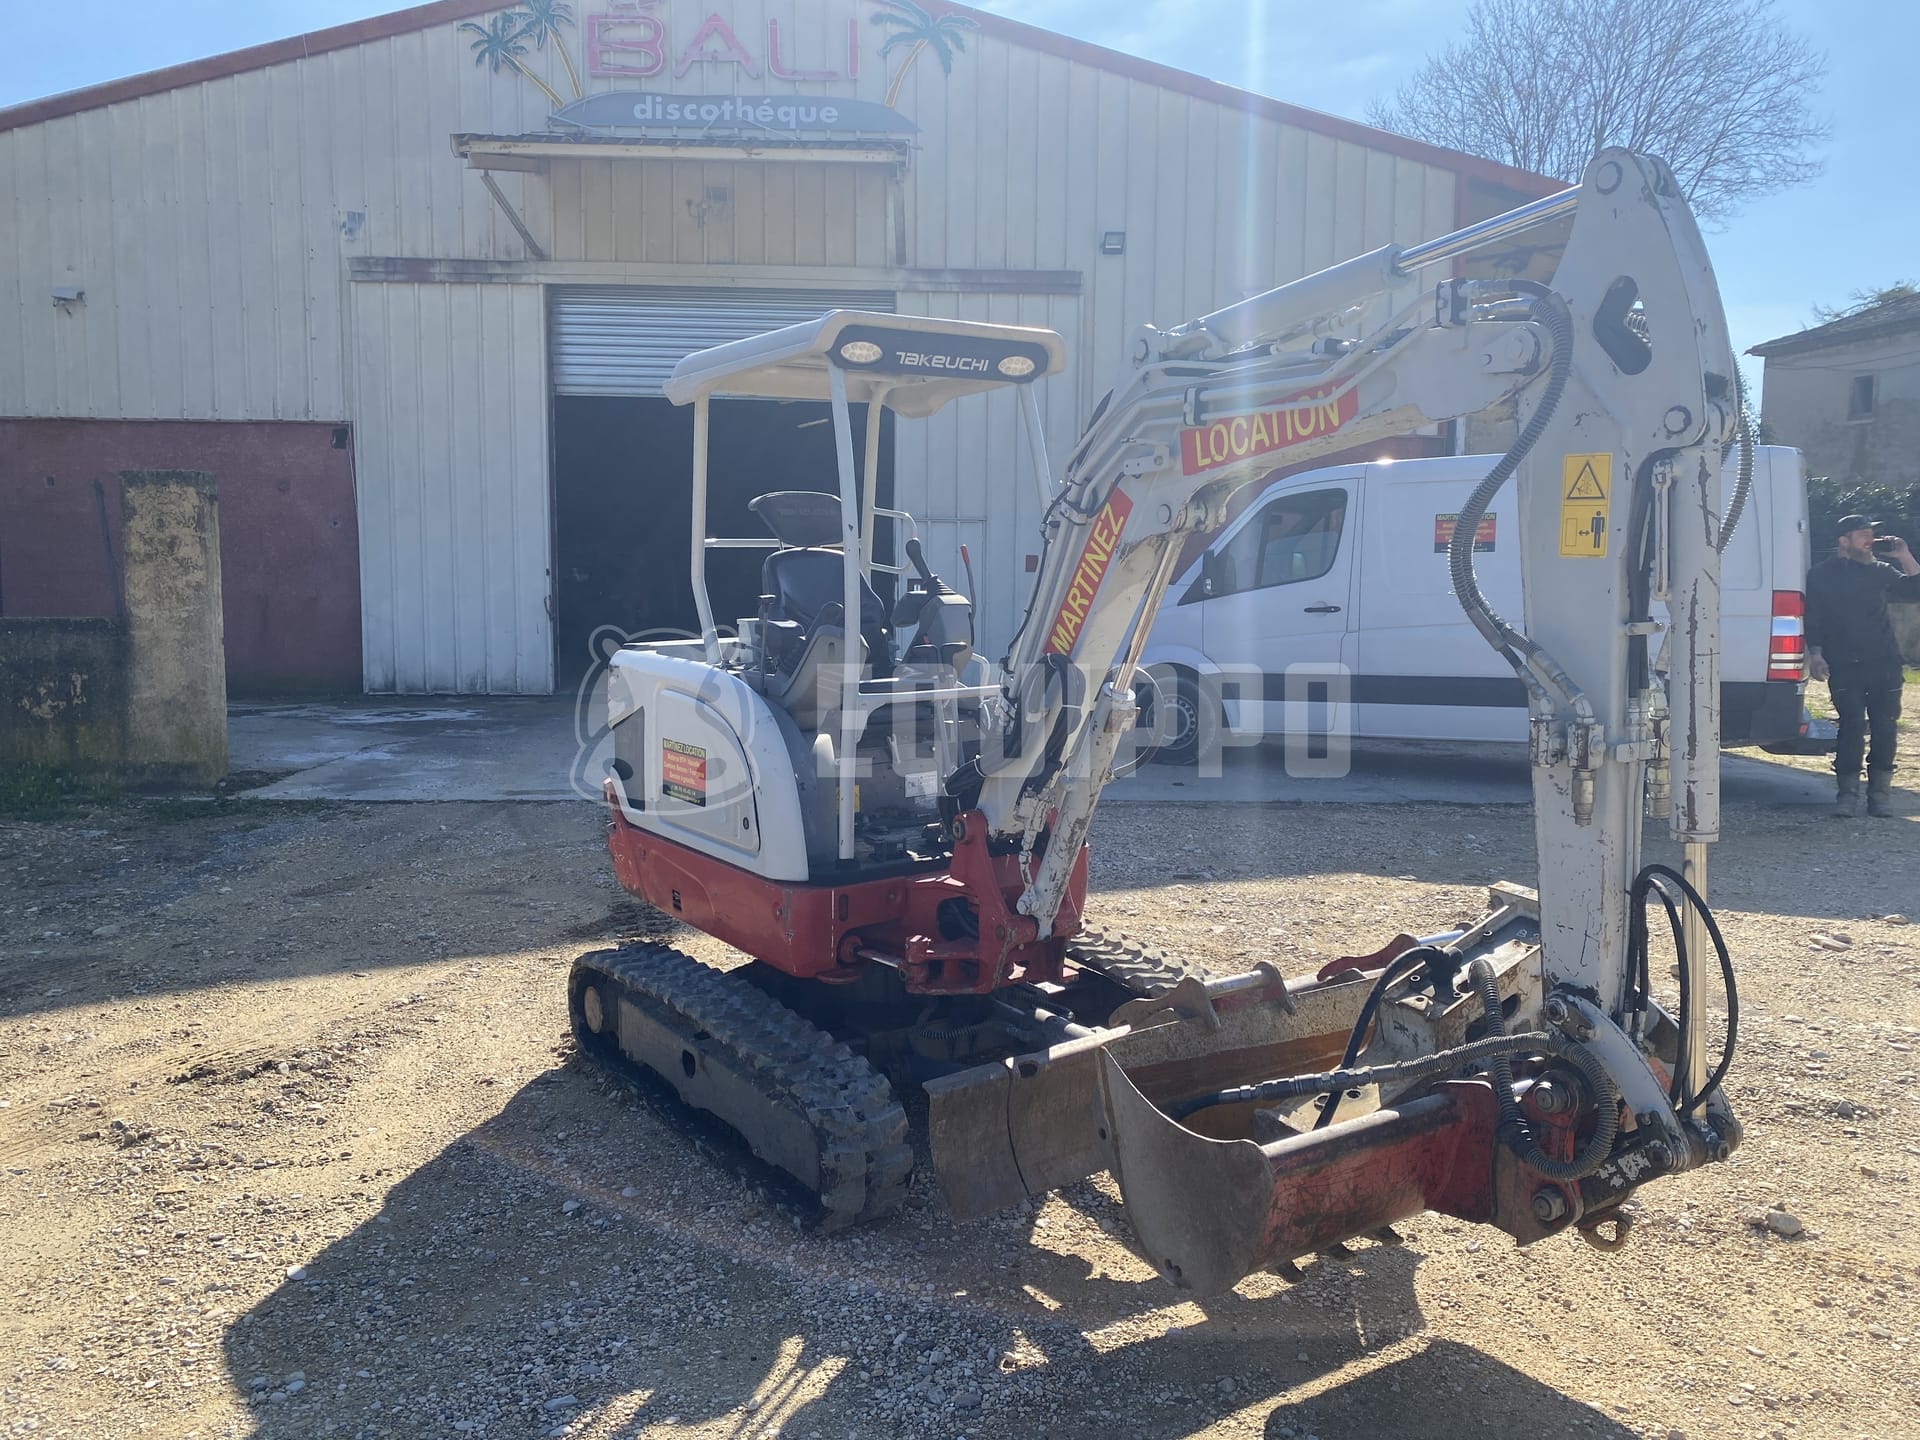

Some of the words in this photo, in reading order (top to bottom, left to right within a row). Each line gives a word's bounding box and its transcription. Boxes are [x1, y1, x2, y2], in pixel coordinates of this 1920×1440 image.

[587, 13, 859, 80] BALI
[896, 351, 989, 371] TAKEUCHI
[1194, 387, 1341, 467] LOCATION
